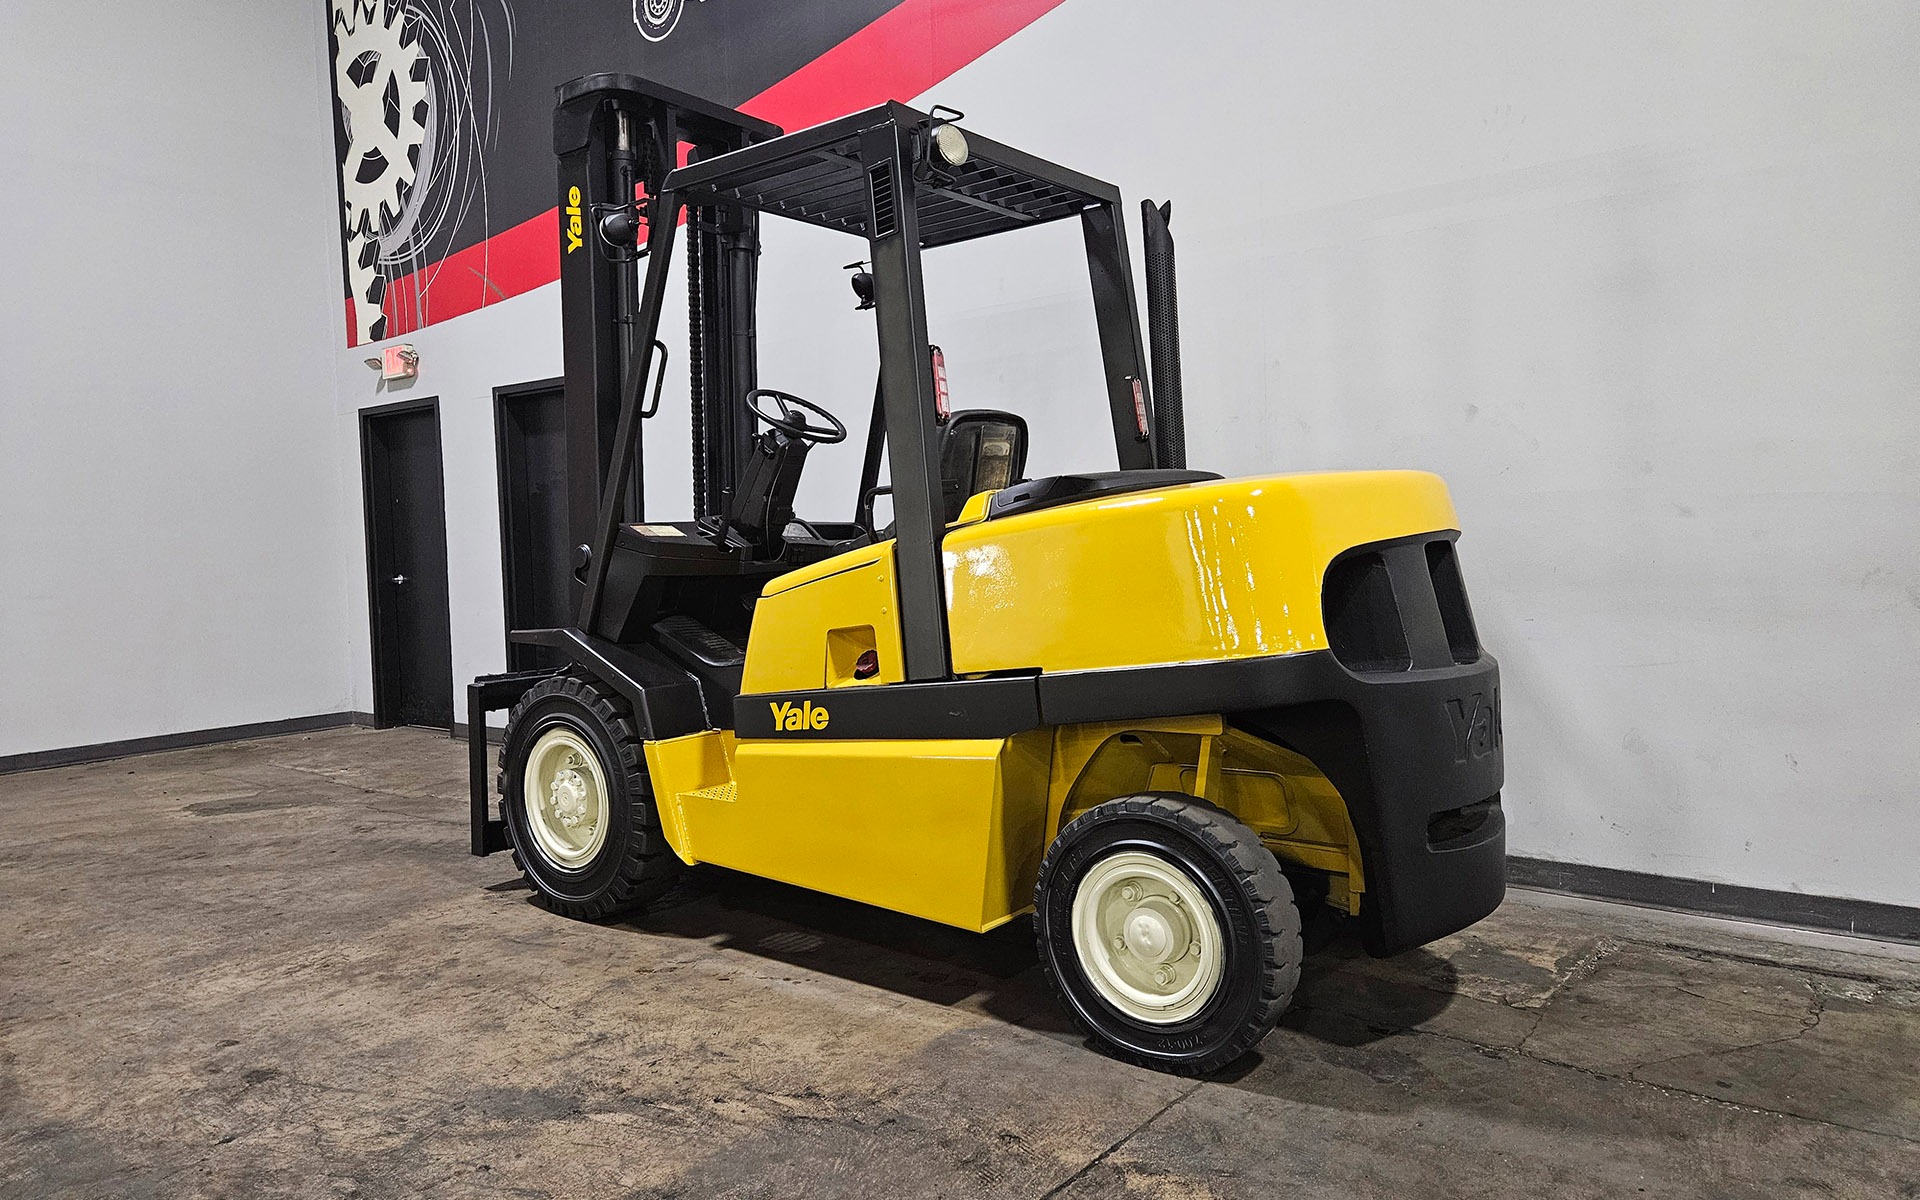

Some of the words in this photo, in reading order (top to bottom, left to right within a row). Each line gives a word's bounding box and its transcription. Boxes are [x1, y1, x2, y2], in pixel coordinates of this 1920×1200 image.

[566, 185, 583, 254] Yale
[769, 700, 830, 731] Yale
[1444, 687, 1502, 763] Yal
